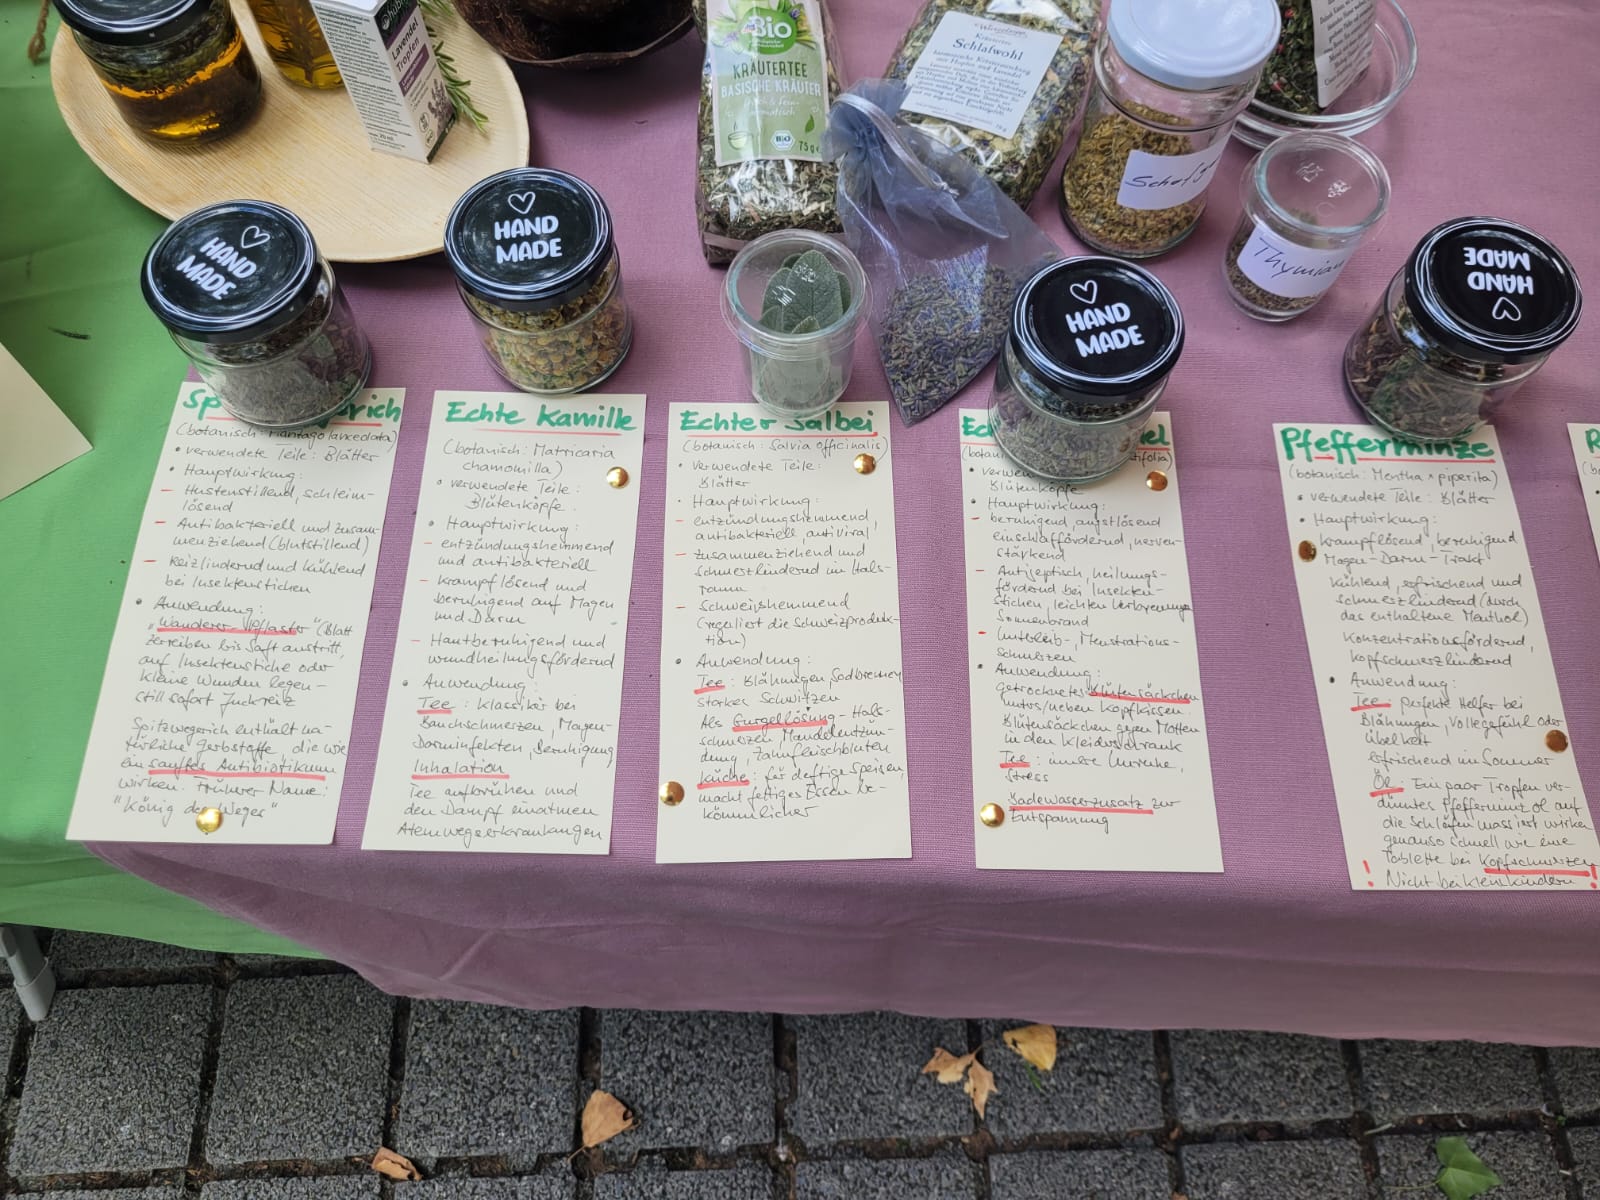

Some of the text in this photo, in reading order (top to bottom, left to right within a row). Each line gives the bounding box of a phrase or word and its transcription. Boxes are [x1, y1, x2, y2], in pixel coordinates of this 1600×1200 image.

[391, 17, 419, 60] Lavendel
[396, 38, 420, 72] Tropfen
[953, 38, 1023, 61] Schlafwohl
[733, 59, 808, 79] KRÄUTERTEE
[721, 78, 821, 98] BASISCHE KRÄUTER
[494, 215, 559, 241] HAND
[199, 236, 257, 281] HAND
[496, 237, 563, 264] MADE
[1464, 246, 1531, 272] MADE
[175, 255, 237, 301] MADE
[1467, 271, 1534, 296] HAND
[1065, 301, 1131, 334] HAND
[1075, 324, 1145, 358] MADE
[445, 401, 637, 431] Echte Kamille
[680, 410, 874, 432] Echter Salbei
[186, 446, 380, 462] verwendete Blätter
[533, 443, 616, 460] Matricaria
[768, 439, 811, 452] Salvia
[1279, 427, 1495, 465] Pfefferminze
[184, 464, 303, 487] Hauptwirkung:
[698, 474, 751, 490] Blätter
[1371, 466, 1423, 482] Mentha
[450, 478, 528, 492] verwendete
[989, 479, 1084, 503] Blütenköpfe
[182, 500, 233, 513] lösend
[1310, 489, 1496, 506] verwendete Blätter
[987, 498, 1106, 520] Hauptwirkung:
[176, 518, 330, 534] Antibakteriell und
[806, 525, 870, 539] antiviral
[1076, 515, 1161, 536] angstlösend
[1314, 511, 1437, 537] Hauptwirkung:
[441, 538, 614, 561] entzündungshemmend
[694, 544, 866, 561] zusammenziehend und
[267, 559, 295, 572] und
[438, 555, 597, 572] und antibakteriell
[826, 567, 846, 575] im
[165, 575, 311, 594] bei Insektenstichen
[555, 581, 587, 592] und
[994, 577, 1056, 603] fördernd
[1063, 582, 1083, 596] bei
[1400, 571, 1522, 598] erfrischend und
[433, 592, 614, 618] beruhigend auf Magen
[1053, 596, 1107, 611] leichten
[434, 610, 526, 624] und Darm
[768, 615, 791, 630] die
[995, 608, 1090, 627] Sonnenbrand
[1340, 609, 1454, 623] das enthaltene
[220, 635, 241, 650] bis
[246, 636, 278, 662] Saft
[431, 633, 606, 654] Hautberuhigend und
[138, 652, 336, 677] auf Insektenstiche oder
[428, 651, 616, 679] wundheilungsfördernd
[196, 675, 261, 689] Wunden
[135, 688, 214, 711] still sofort
[555, 694, 577, 712] bei
[760, 689, 841, 706] Schwitzen
[1459, 694, 1524, 716] Helfer bei
[132, 716, 297, 746] Spitzwegerich enthält
[1002, 714, 1201, 745] Blütensäckchen gegen Motten
[292, 740, 318, 754] die
[324, 740, 348, 756] wie
[1005, 733, 1184, 753] in den Kleiderschrank
[121, 756, 144, 769] ein
[216, 758, 336, 774] Antibiotikum
[413, 758, 506, 775] Inhalation
[1368, 748, 1555, 772] erfrischend im Sommer
[764, 764, 850, 793] für deftige
[1411, 775, 1539, 799] Ein paar Tropfen
[409, 781, 579, 802] Tee aufbrühen und
[698, 783, 848, 810] macht fettiges Essen
[1007, 791, 1182, 810] Badewasserzusatz zur
[403, 802, 437, 817] den
[441, 799, 505, 825] Dampf
[1554, 799, 1582, 817] auf
[1011, 811, 1109, 835] Entspannung
[1382, 815, 1404, 830] die
[1383, 832, 1576, 853] genauso schnell wie eine
[1382, 849, 1472, 865] Tablette bei
[1385, 868, 1435, 889] Nicht
